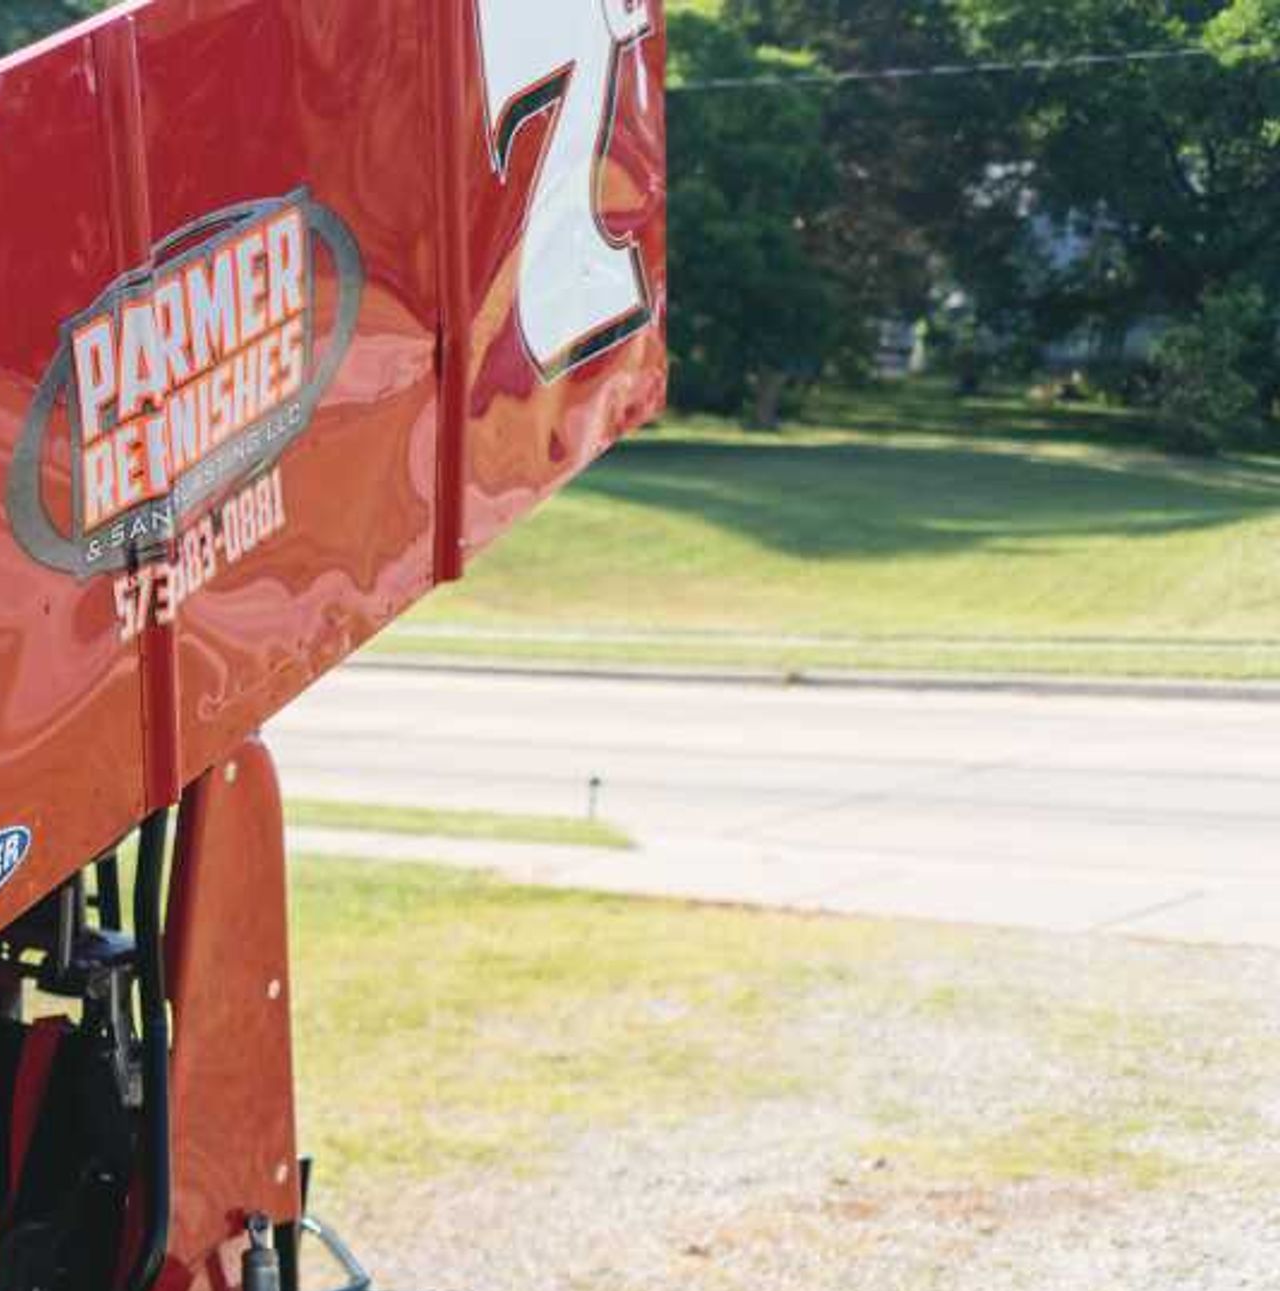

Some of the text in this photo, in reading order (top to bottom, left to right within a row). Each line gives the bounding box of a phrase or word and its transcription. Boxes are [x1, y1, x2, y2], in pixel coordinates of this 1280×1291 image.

[74, 209, 305, 438] PARMER
[83, 320, 305, 530] REFNISHES
[85, 539, 102, 562] &
